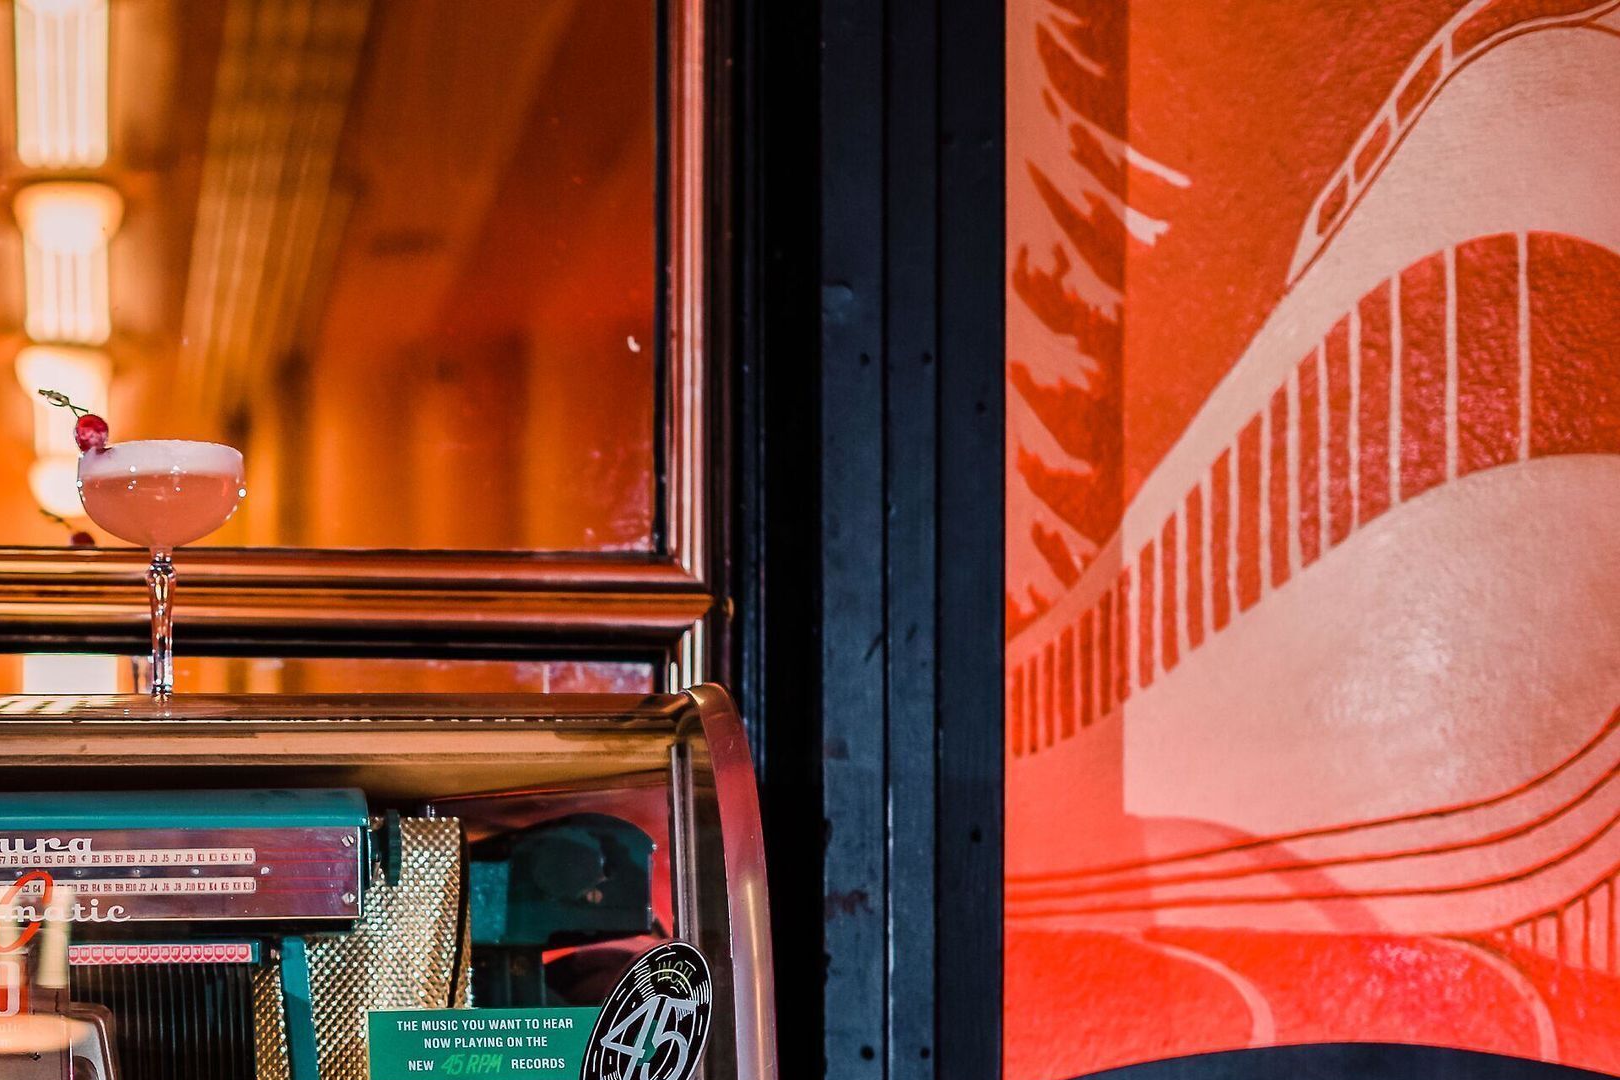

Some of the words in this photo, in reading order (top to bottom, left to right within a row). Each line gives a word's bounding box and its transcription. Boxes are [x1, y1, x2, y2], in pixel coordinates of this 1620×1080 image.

[397, 1020, 419, 1031] THE
[422, 1019, 458, 1031] MUSIC
[462, 1019, 485, 1030] YOU
[488, 1019, 521, 1029] WANT
[524, 1019, 539, 1029] TO
[543, 1018, 573, 1029] HEAR
[424, 1038, 451, 1048] NOW
[454, 1037, 503, 1048] PLAYING
[507, 1037, 522, 1048] ON
[526, 1037, 548, 1047] THE
[408, 1061, 434, 1071] NEW
[441, 1054, 464, 1074] 45
[467, 1054, 502, 1073] RPM
[511, 1058, 565, 1069] RECORDS
